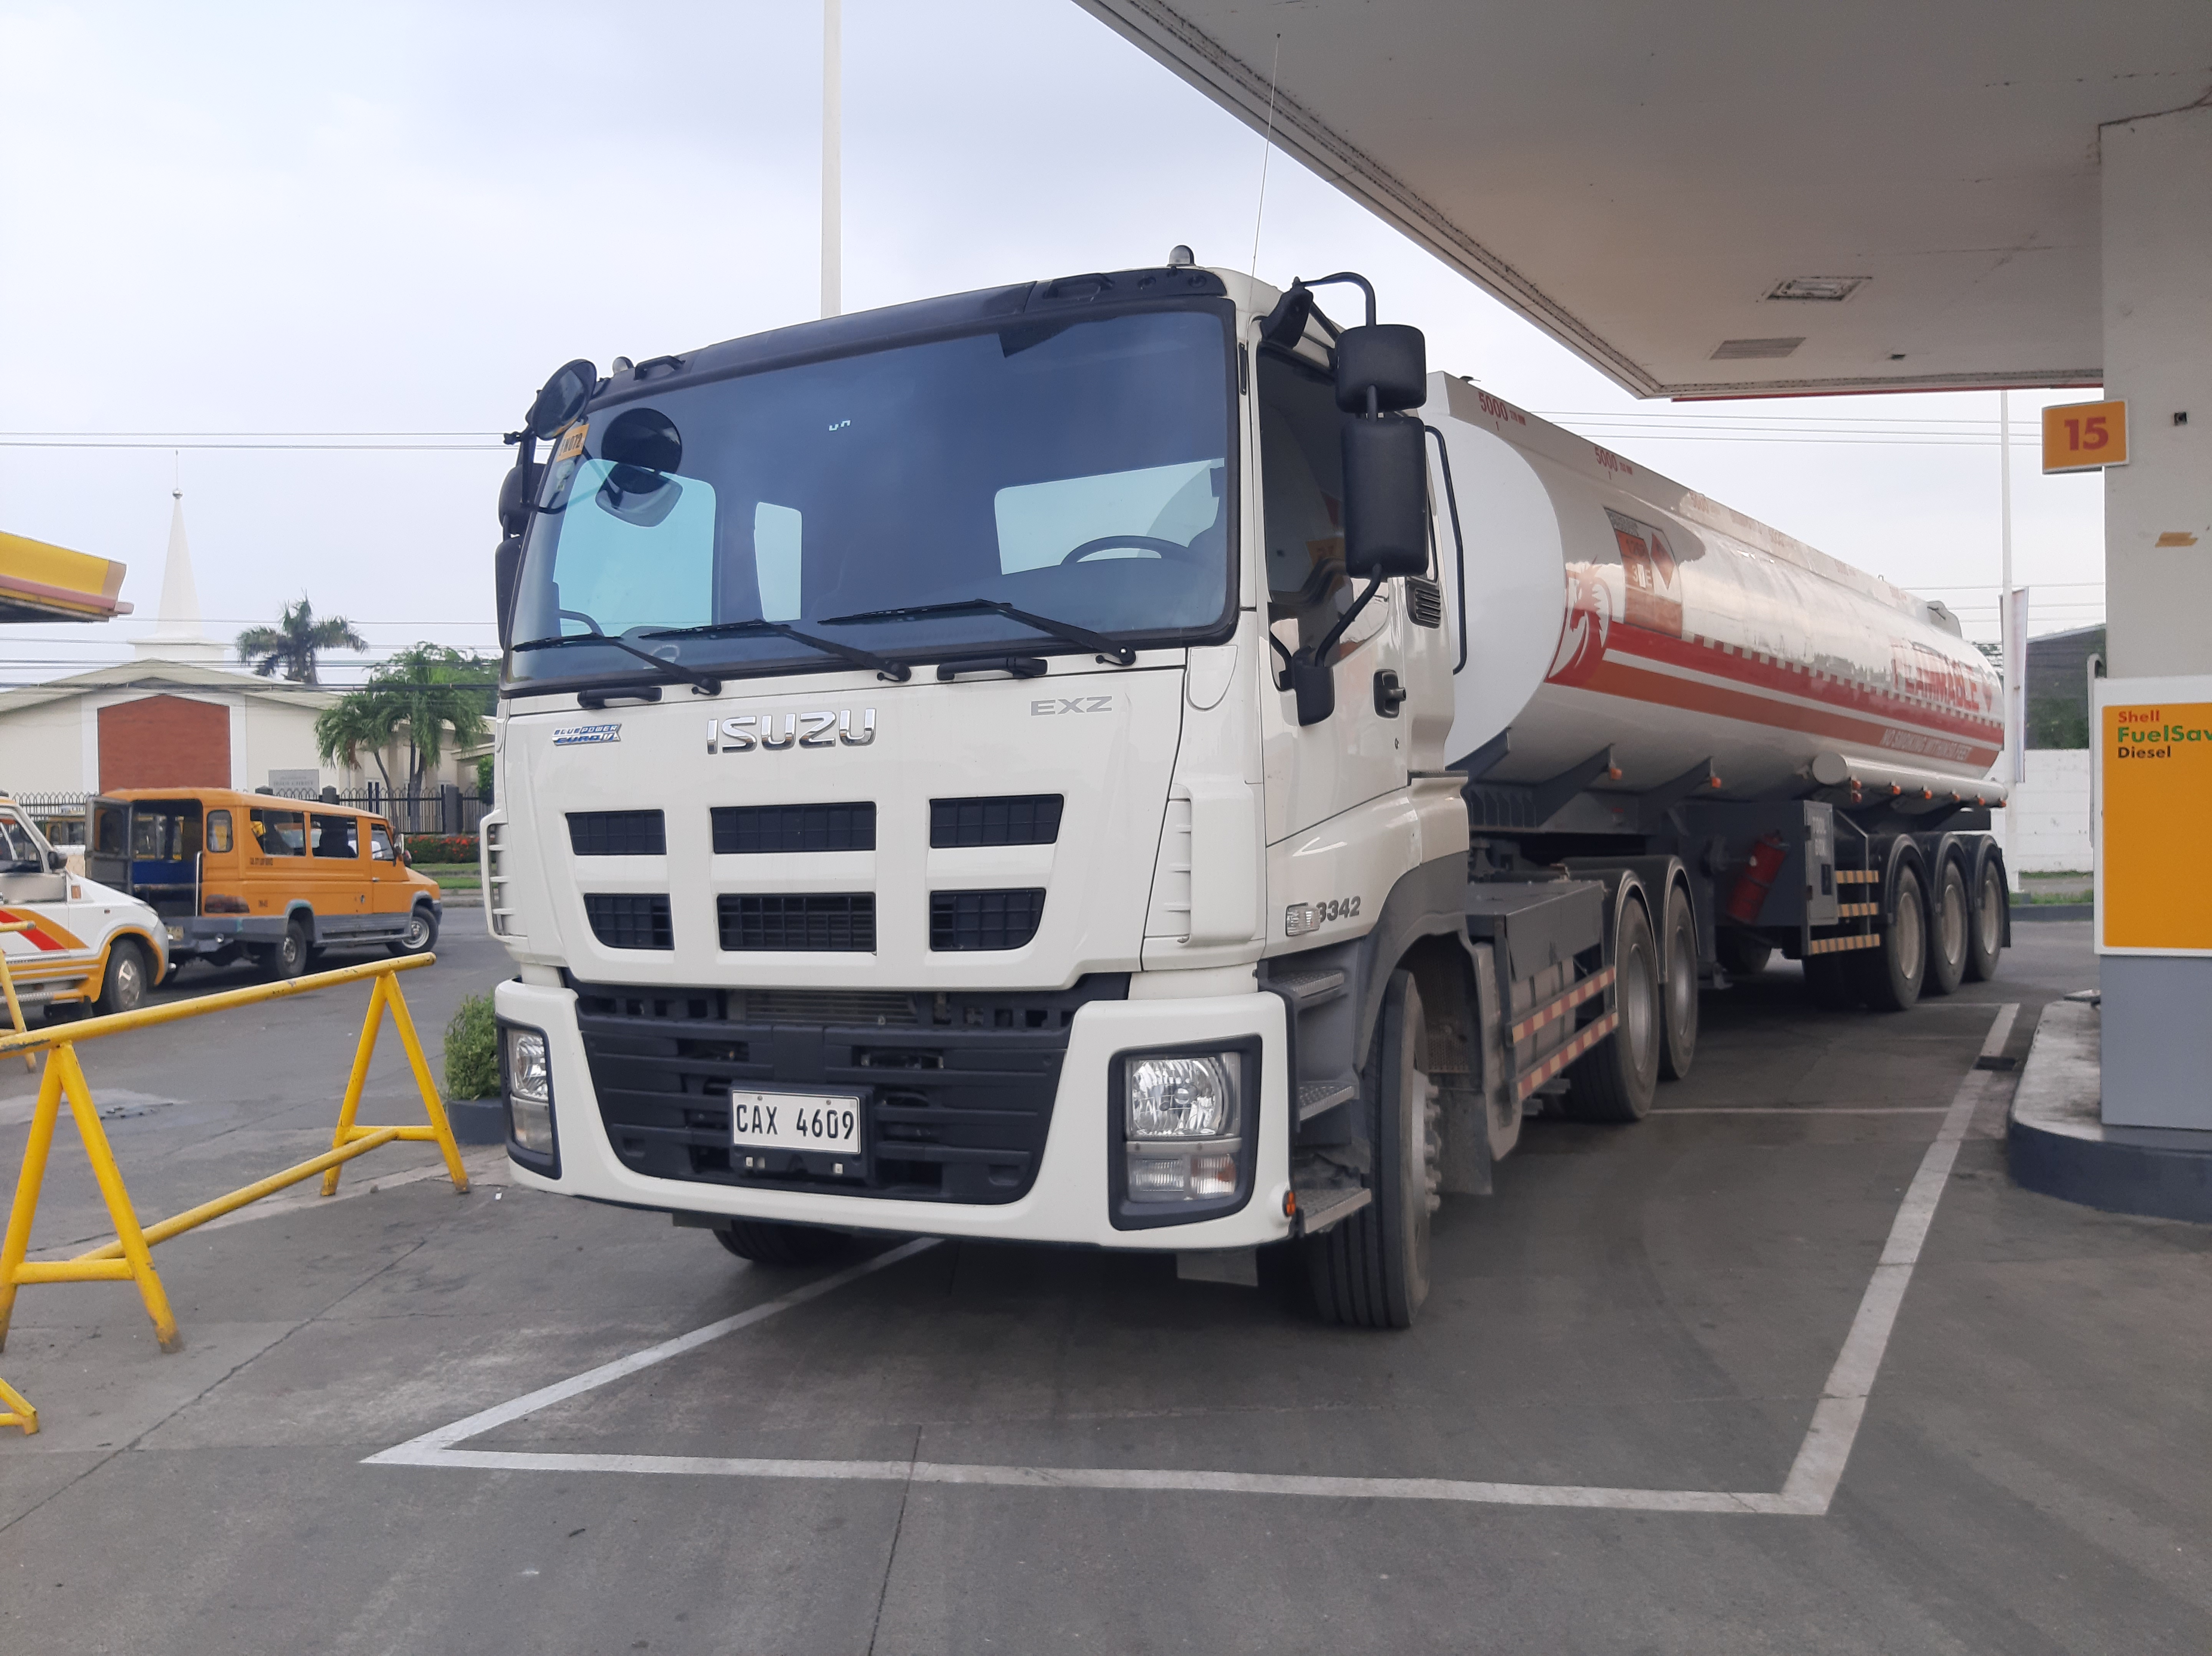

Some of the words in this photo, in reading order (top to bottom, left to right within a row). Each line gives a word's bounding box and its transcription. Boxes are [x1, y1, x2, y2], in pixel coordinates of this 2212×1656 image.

[1479, 391, 1508, 421] 5000
[2064, 416, 2109, 451] 15
[1594, 446, 1618, 472] 5000
[1031, 696, 1112, 716] EXZ
[2118, 709, 2160, 723] Shell
[707, 708, 877, 755] ISUZU
[2118, 746, 2171, 758] Diesel
[737, 1104, 778, 1135] CAX
[796, 1108, 854, 1139] 4609
